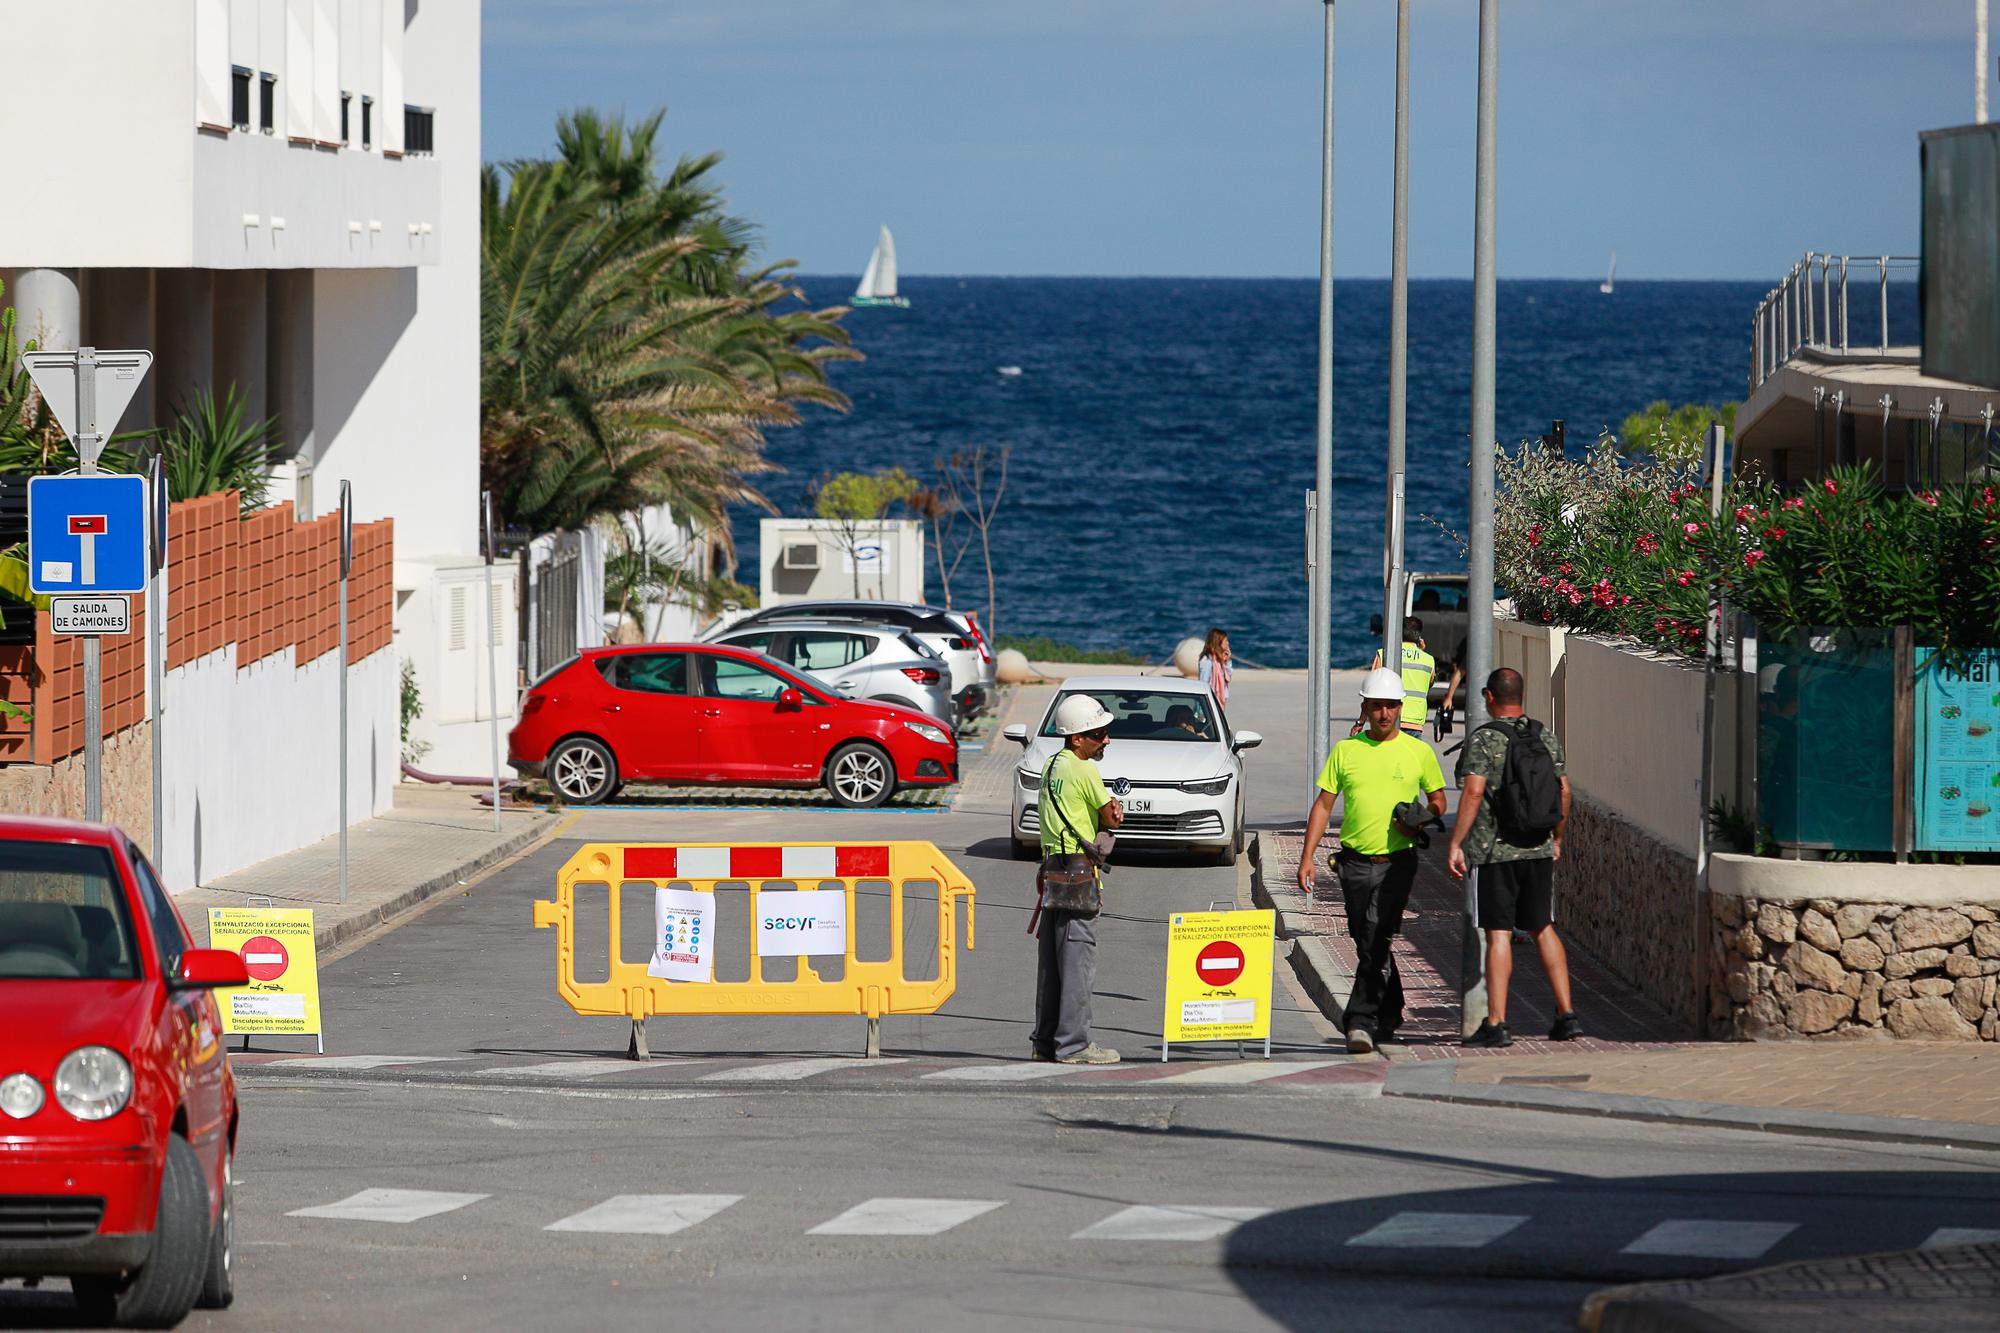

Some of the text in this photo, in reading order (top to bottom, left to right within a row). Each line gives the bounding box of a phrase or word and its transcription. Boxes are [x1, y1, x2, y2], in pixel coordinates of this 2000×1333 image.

[73, 604, 108, 613] SALIDA
[56, 617, 124, 627] DE CAMIONES
[1128, 801, 1151, 811] LSM
[764, 917, 816, 931] sacyr
[1225, 924, 1271, 932] EXCEPCIONAL
[1224, 931, 1270, 939] EXCEPCIONAL
